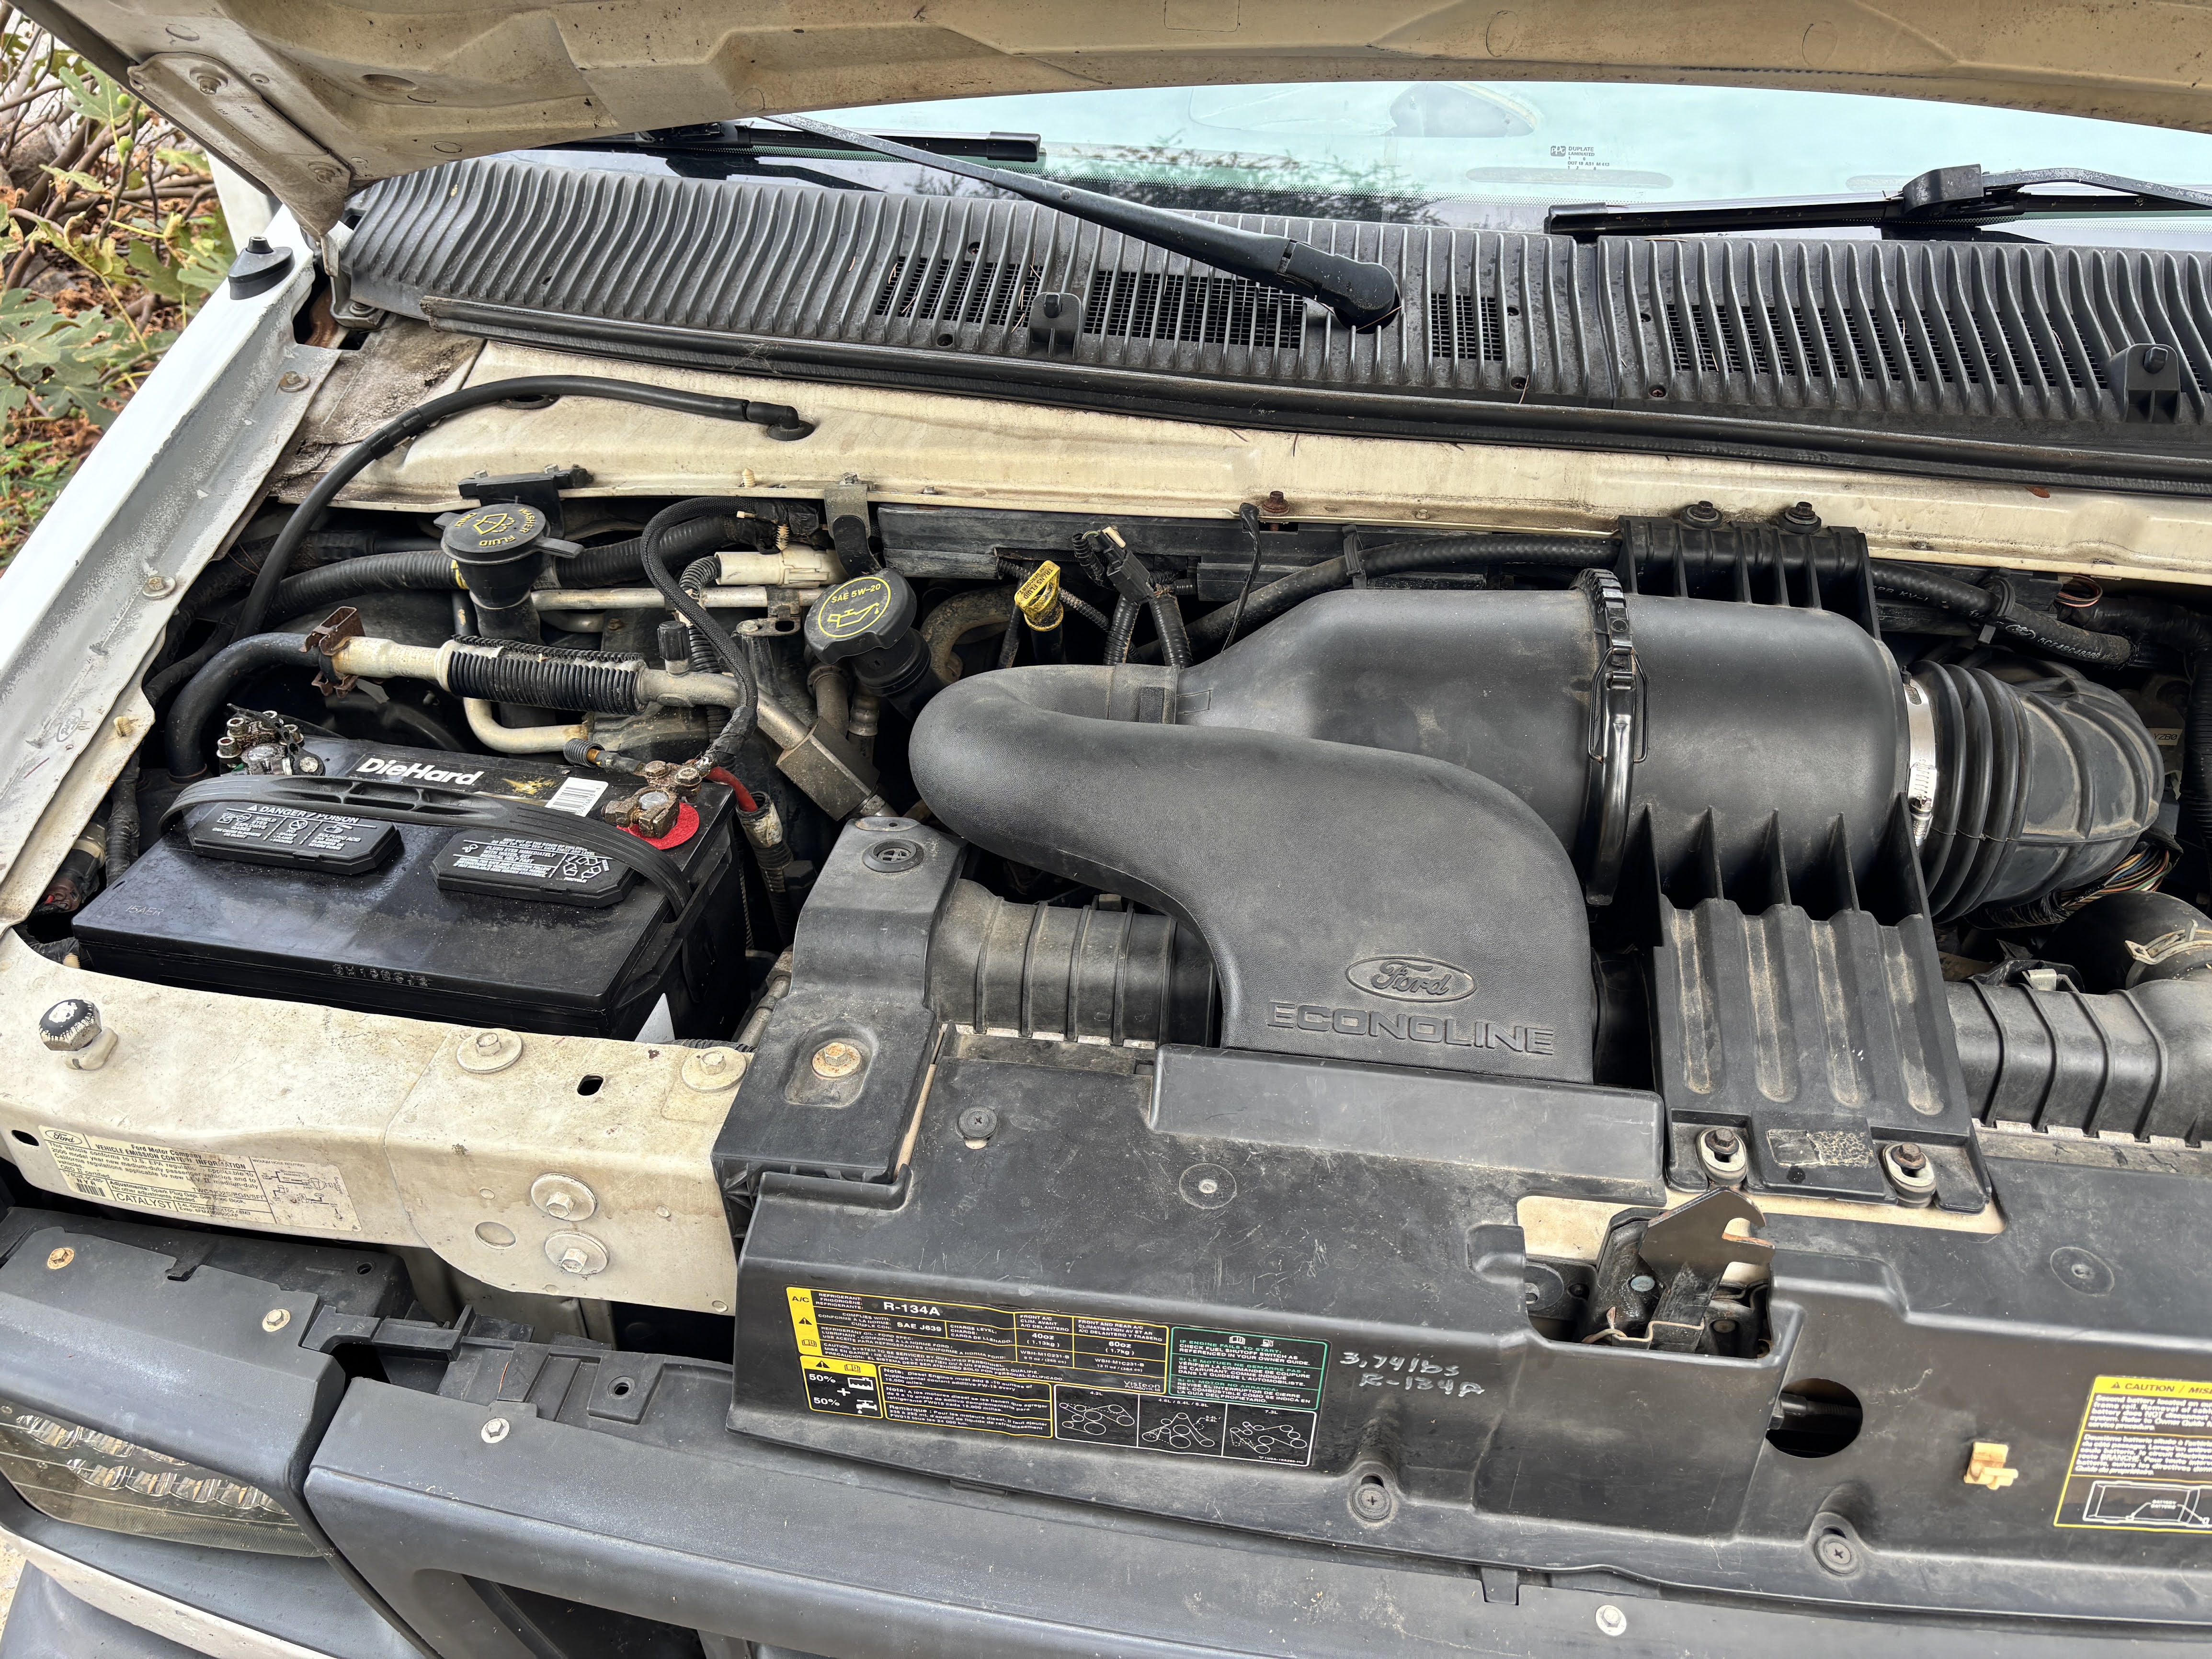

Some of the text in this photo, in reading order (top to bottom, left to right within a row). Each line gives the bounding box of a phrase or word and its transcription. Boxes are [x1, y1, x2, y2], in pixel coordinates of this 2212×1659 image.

[455, 513, 477, 527] ONLY
[519, 508, 536, 534] WASHER
[479, 535, 515, 546] FLUID
[1024, 568, 1053, 599] TRANS FLUID
[832, 584, 880, 603] SAE 5W-20
[356, 758, 484, 785] DieHard
[260, 807, 359, 823] DANGER POISON
[518, 849, 556, 857] IMMEDIATELY
[1371, 960, 1449, 996] Ford
[1267, 1001, 1554, 1055] ECONOLINE
[54, 1132, 75, 1143] Ford
[90, 1151, 120, 1159] conforms
[95, 1144, 124, 1153] VEHICLE
[125, 1149, 159, 1159] EMISSION
[171, 1148, 202, 1159] Company
[55, 1153, 85, 1163] California
[87, 1161, 123, 1171] regulations
[125, 1167, 159, 1177] applicable
[121, 1161, 163, 1172] medium-duty
[111, 1181, 149, 1191] Adjustments:
[116, 1193, 172, 1209] CATALYST
[884, 1302, 940, 1316] R-134A
[1078, 1324, 1124, 1332] CLIMATISATION
[1179, 1348, 1226, 1356] REFERENCED
[809, 1374, 836, 1383] 50%
[1124, 1380, 1160, 1388] Visteon
[1214, 1386, 1262, 1394] INTERRUPTOR
[1359, 1373, 1485, 1397] R-134A
[2125, 1383, 2175, 1392] CAUTION
[1192, 1387, 1241, 1396] COMBUSTIBLE
[814, 1397, 840, 1406] 50%
[889, 1405, 927, 1413] Remarque
